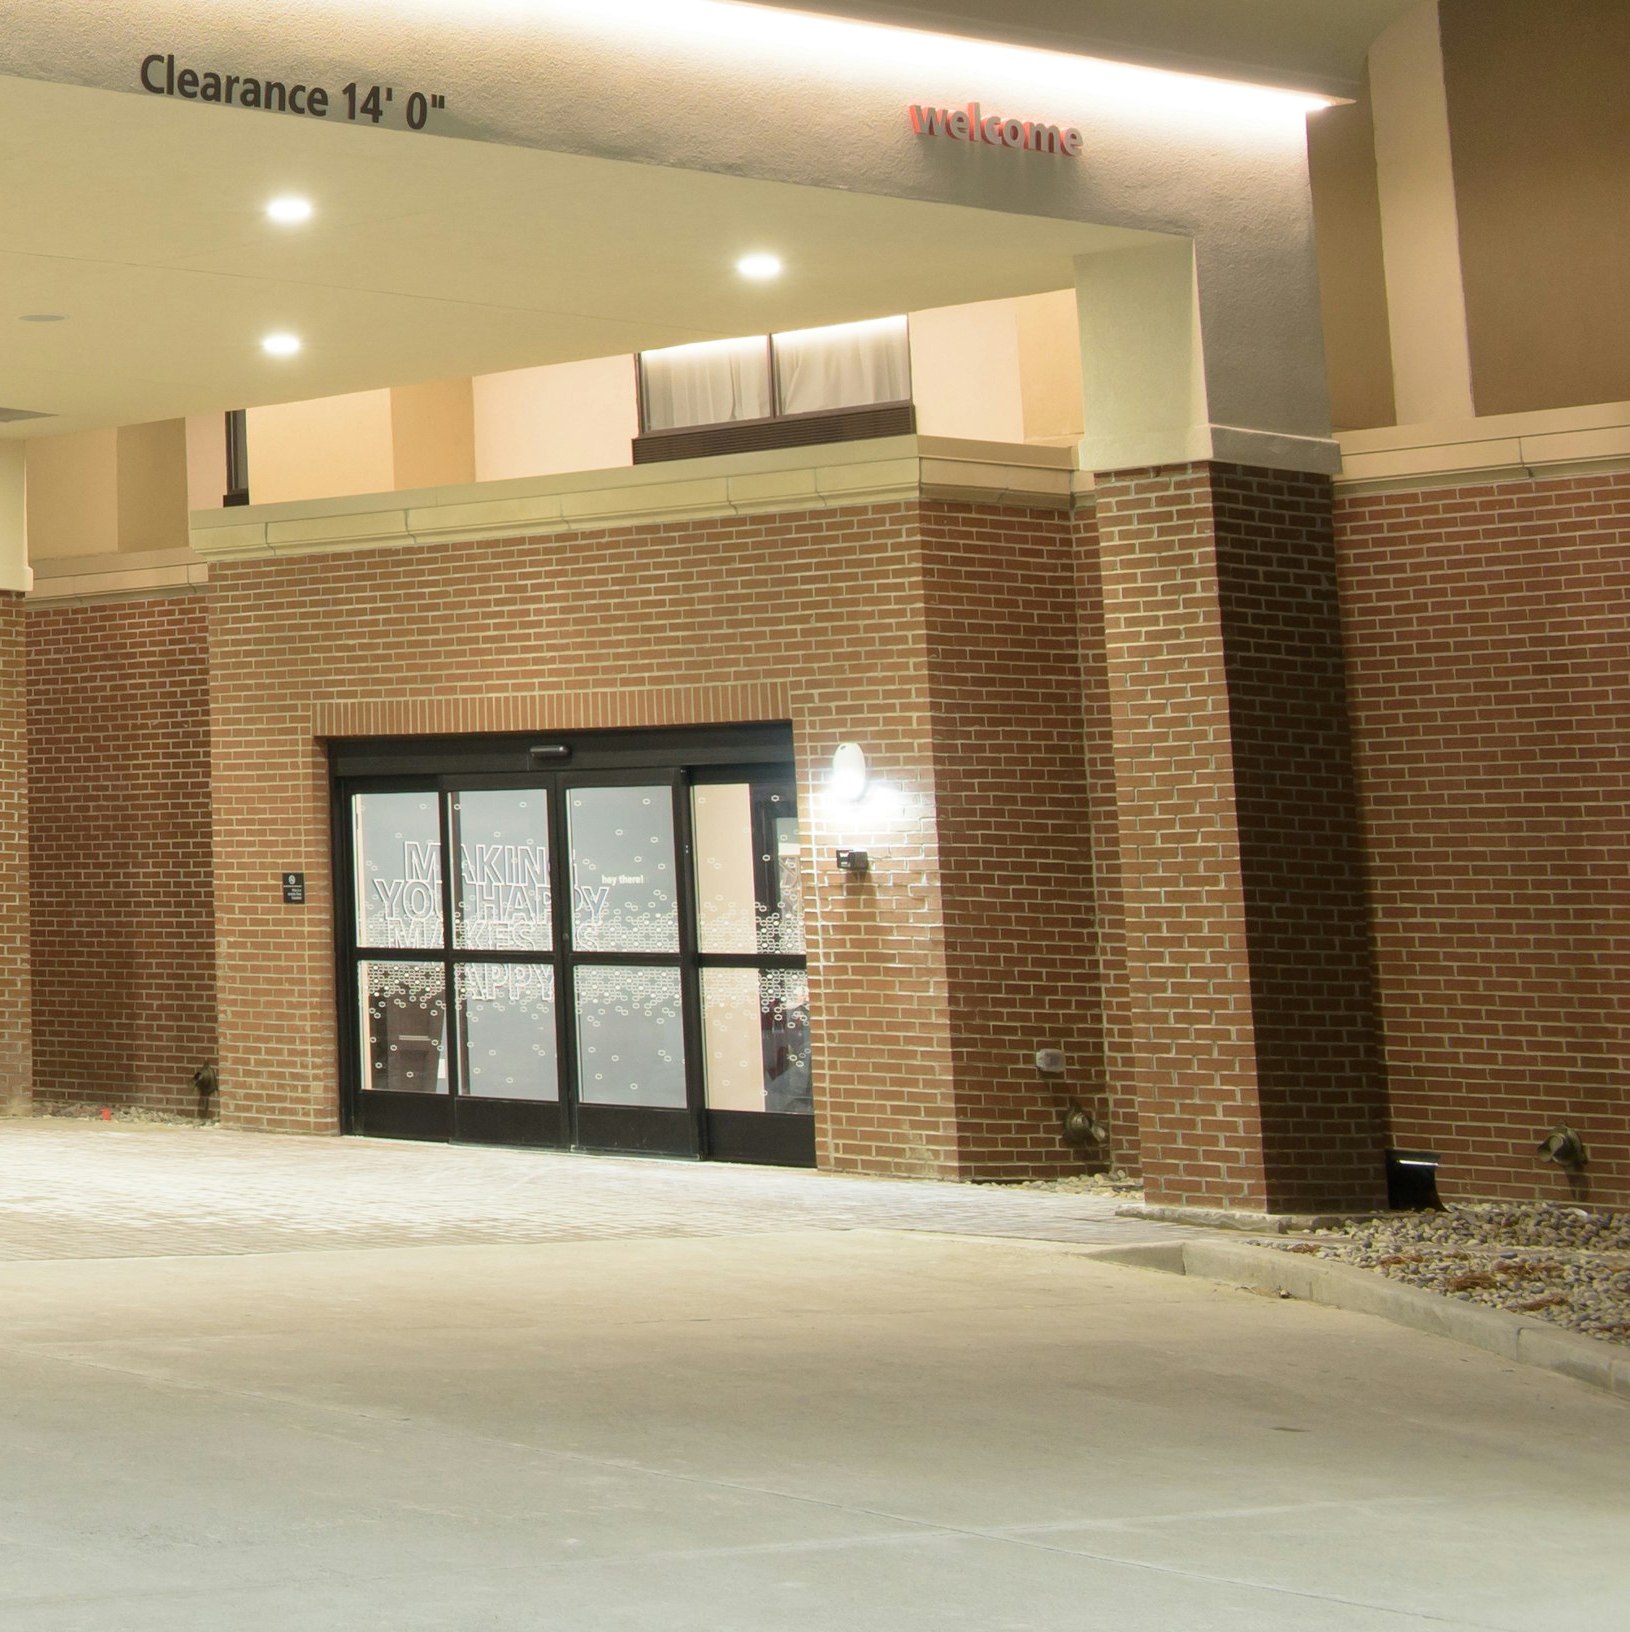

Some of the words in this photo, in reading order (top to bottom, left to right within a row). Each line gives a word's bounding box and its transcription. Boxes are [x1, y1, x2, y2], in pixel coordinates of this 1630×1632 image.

[140, 53, 329, 117] Clearance
[341, 81, 394, 124] 14'
[406, 91, 445, 130] 0"
[909, 101, 1084, 157] welcome
[403, 840, 579, 888] MAKIN
[601, 874, 617, 886] hey
[618, 874, 644, 884] there!
